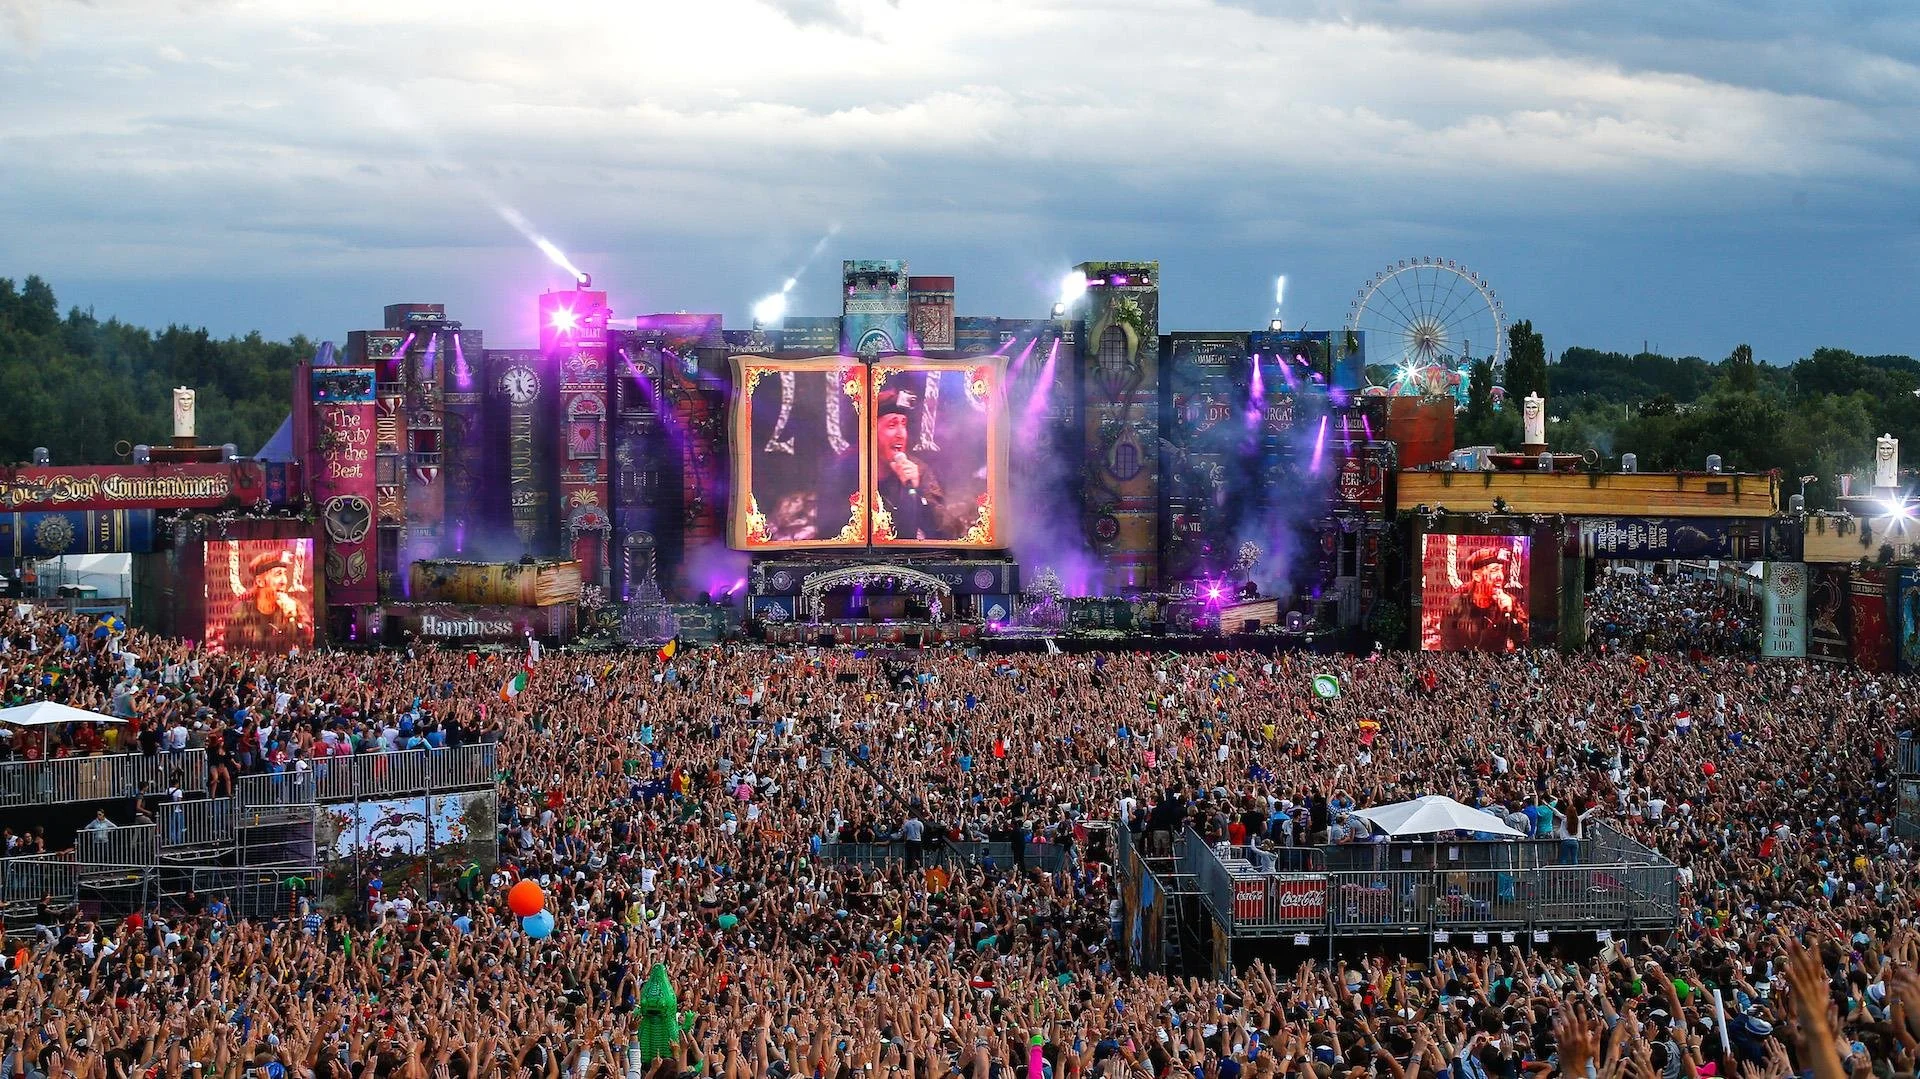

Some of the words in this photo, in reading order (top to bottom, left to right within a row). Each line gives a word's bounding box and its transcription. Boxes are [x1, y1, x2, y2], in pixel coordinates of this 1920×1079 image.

[328, 408, 361, 427] The
[325, 426, 370, 445] eauty
[344, 443, 368, 461] the
[327, 460, 363, 479] Beat
[101, 472, 229, 500] Commandments
[101, 522, 109, 542] VIII
[1776, 603, 1793, 614] THE
[421, 615, 513, 638] Happiness
[1773, 616, 1795, 627] BOOK
[1778, 628, 1790, 639] OF
[1773, 640, 1795, 651] LOVE
